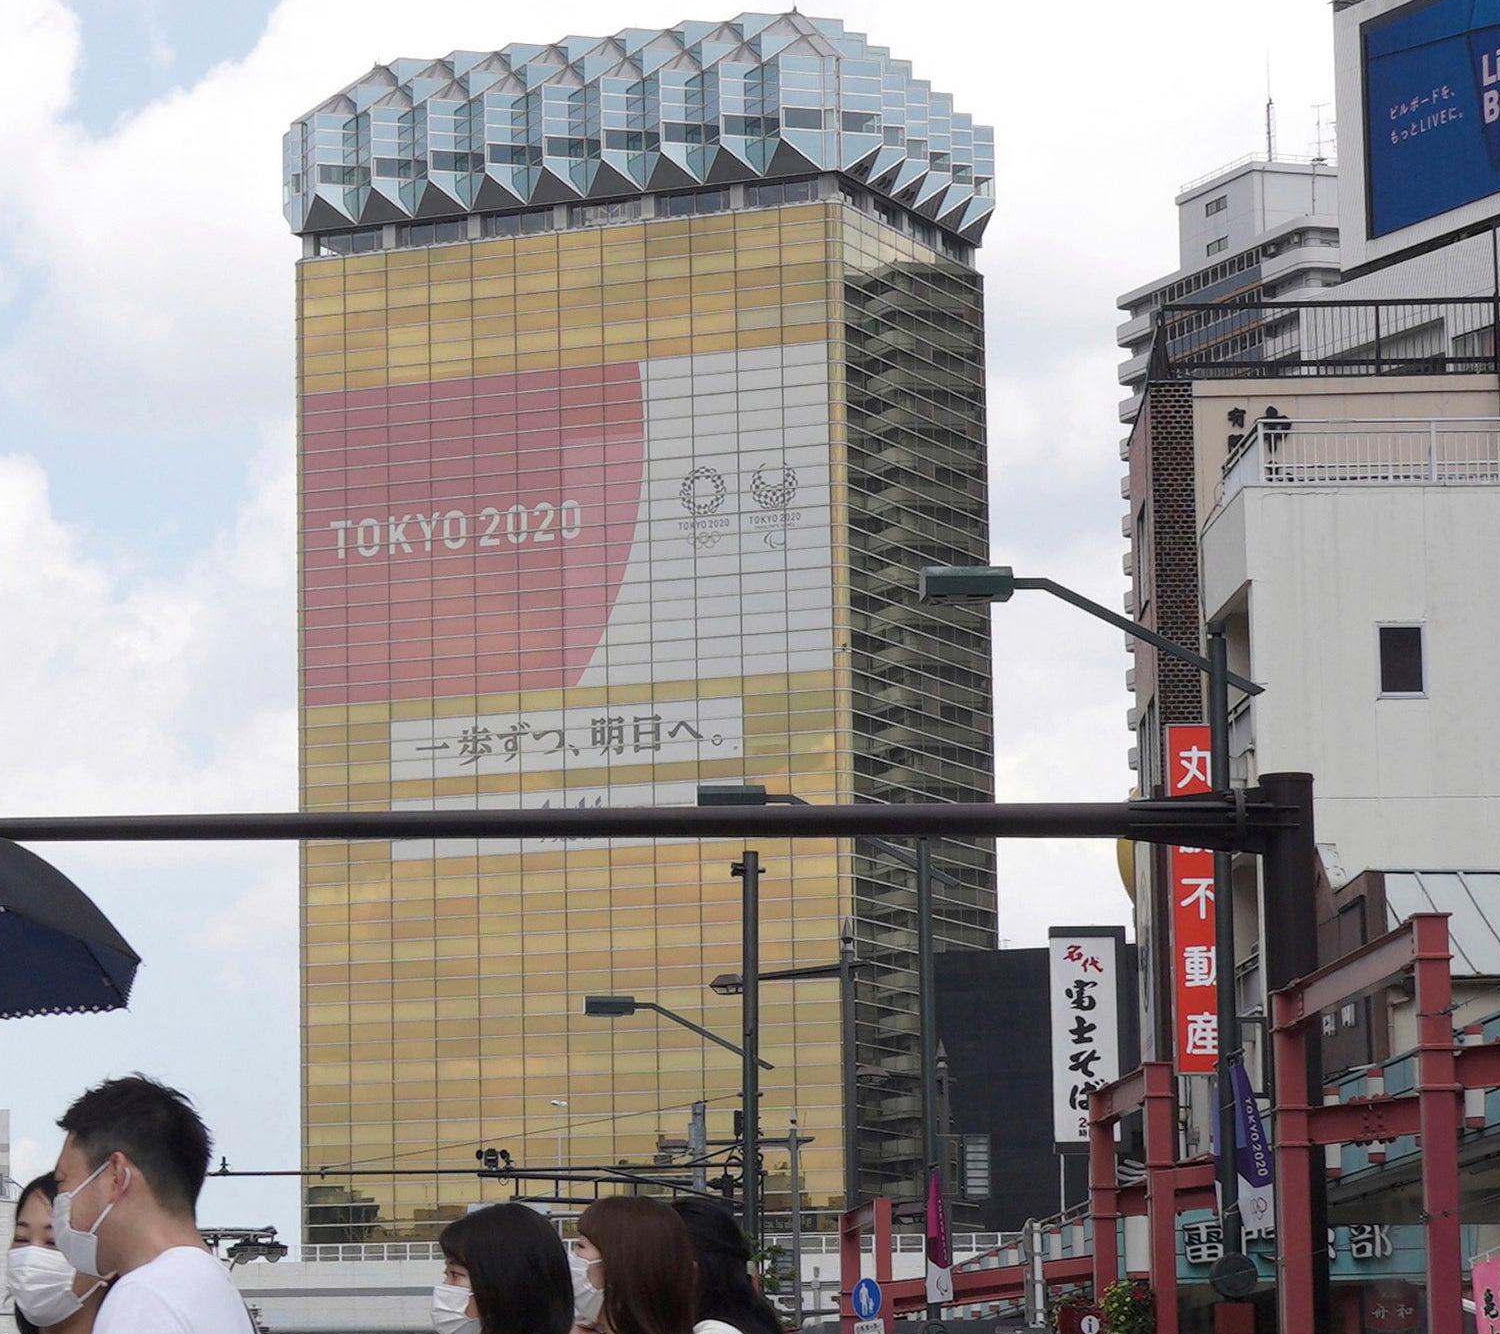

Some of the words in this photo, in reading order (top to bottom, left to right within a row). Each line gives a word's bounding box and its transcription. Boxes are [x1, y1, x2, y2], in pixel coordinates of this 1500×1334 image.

[1388, 84, 1456, 121] ビルボードを、
[1389, 107, 1465, 144] もっとLIVEに。
[328, 510, 468, 560] TOKYO
[478, 499, 583, 552] 2020
[678, 519, 707, 531] TOKYO
[708, 518, 730, 529] 2020
[748, 514, 778, 525] TOKYO
[778, 511, 802, 523] 2020
[415, 713, 724, 766] 一歩ずつ、明日へ。
[1177, 745, 1218, 1056] 丸不動産
[1063, 944, 1104, 973] 名代
[1064, 979, 1106, 1111] 富士そば
[1244, 1094, 1260, 1142] TOKYO
[1252, 1142, 1269, 1178] 2020
